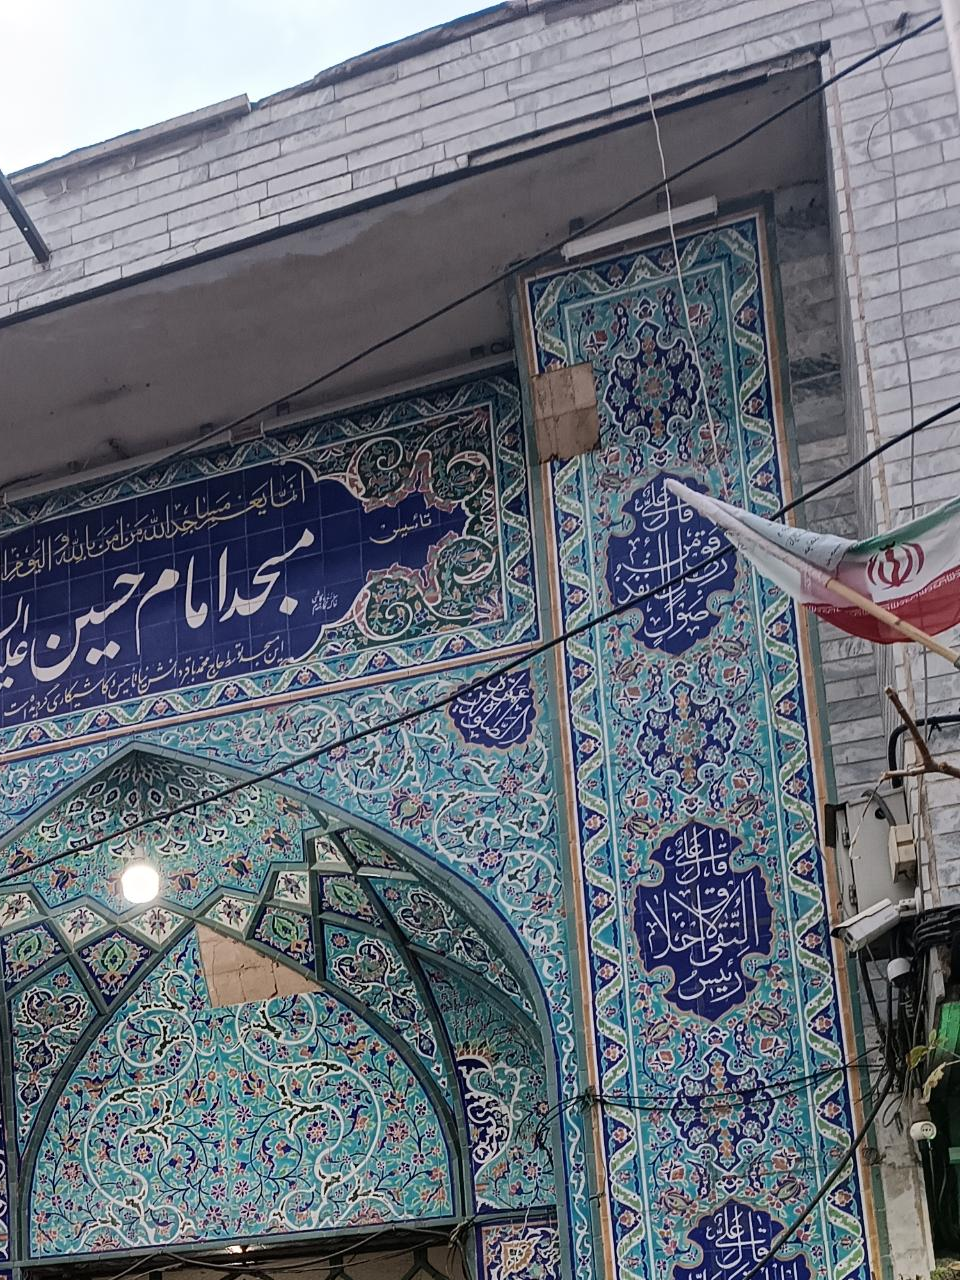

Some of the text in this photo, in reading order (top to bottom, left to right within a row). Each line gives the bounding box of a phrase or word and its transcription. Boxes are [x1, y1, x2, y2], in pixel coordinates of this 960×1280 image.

[30, 568, 145, 682] حسین
[136, 547, 229, 655] امام
[219, 528, 315, 623] مسجد
[206, 653, 224, 679] حاج
